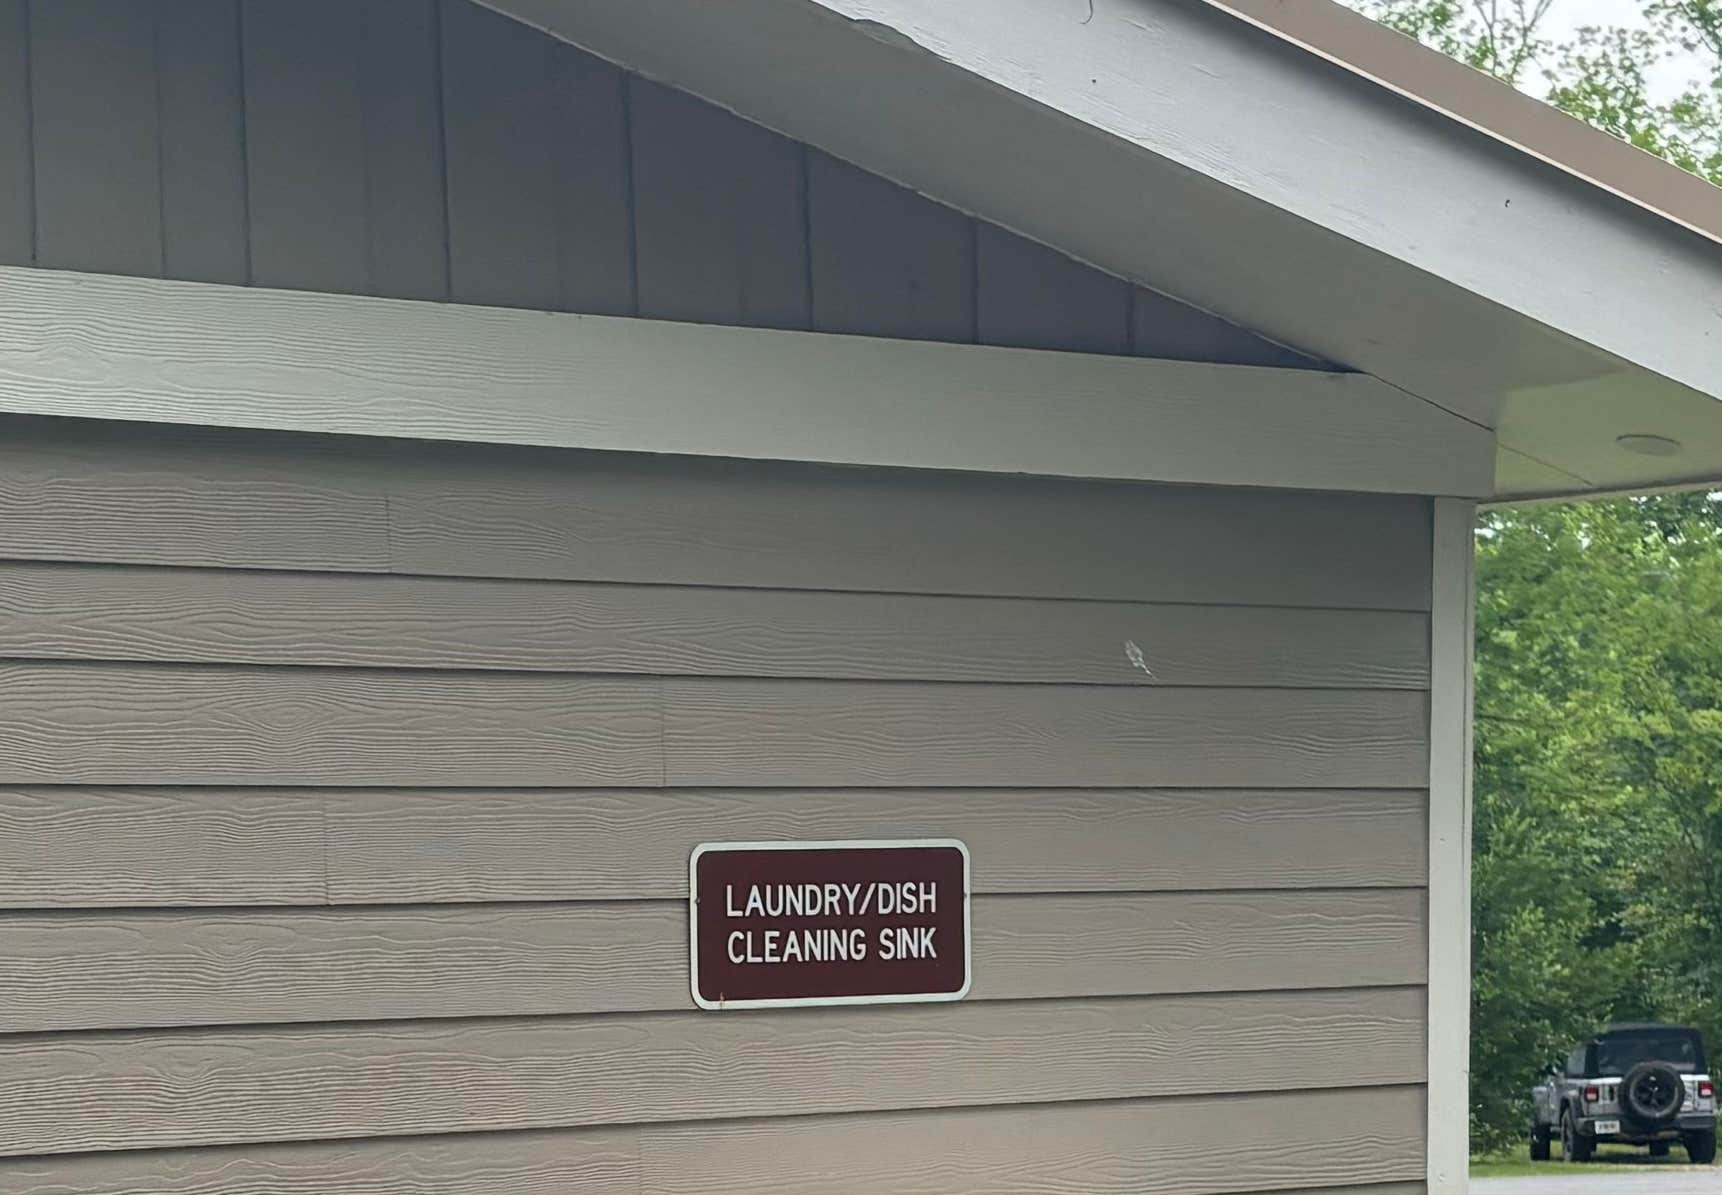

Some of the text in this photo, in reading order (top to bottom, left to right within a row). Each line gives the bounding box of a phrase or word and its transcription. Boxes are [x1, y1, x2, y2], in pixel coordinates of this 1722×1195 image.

[726, 882, 937, 917] LAUNDRY/DISH
[727, 927, 937, 964] CLEANING SINK
